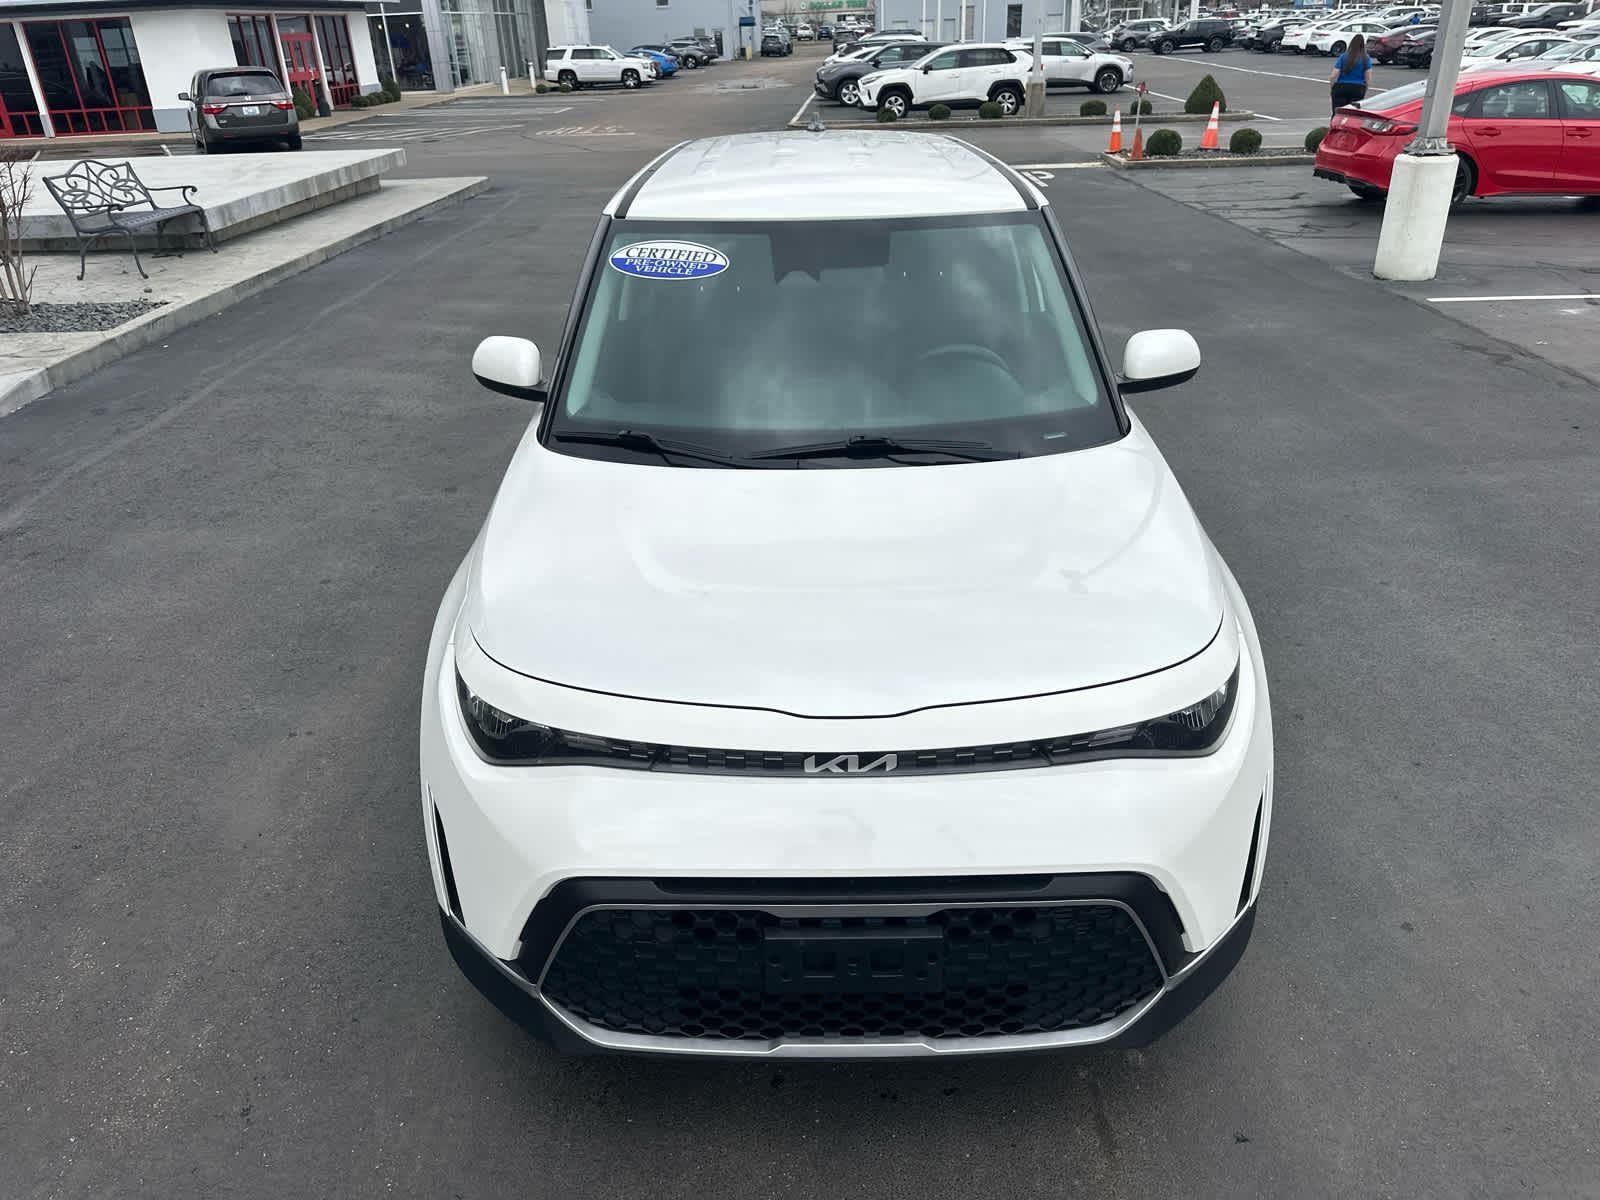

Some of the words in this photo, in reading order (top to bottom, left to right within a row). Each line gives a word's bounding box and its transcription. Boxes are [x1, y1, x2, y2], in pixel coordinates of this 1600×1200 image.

[625, 247, 718, 263] CERTIFIED
[625, 258, 708, 270] PRE-OWNED
[635, 265, 694, 275] VEHICLE
[804, 753, 897, 773] KIA
